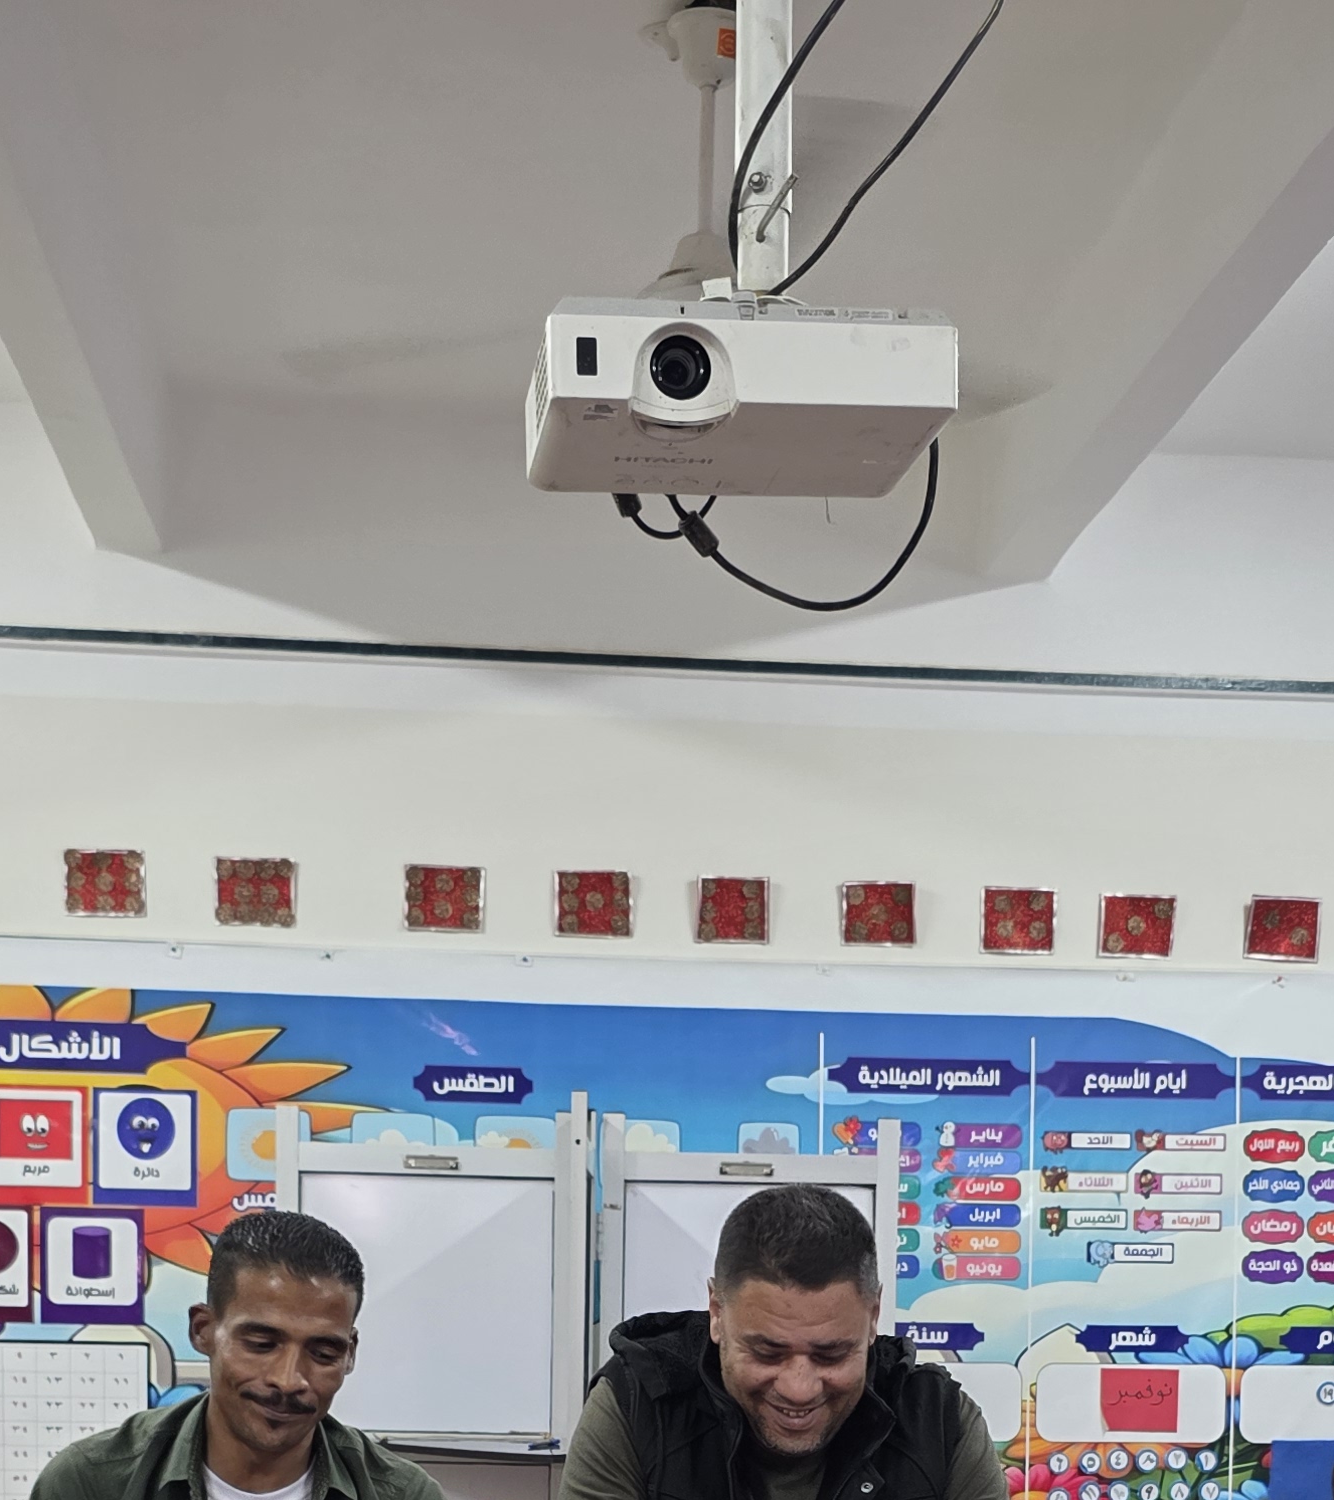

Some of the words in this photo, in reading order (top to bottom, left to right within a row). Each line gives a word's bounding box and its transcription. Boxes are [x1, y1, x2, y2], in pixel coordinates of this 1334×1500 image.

[432, 1073, 515, 1095] الطقس
[858, 1065, 931, 1088] الميلادية
[935, 1065, 1001, 1091] الشهور
[1083, 1070, 1151, 1096] الأسبوع
[970, 1129, 1003, 1144] يناير
[1175, 1137, 1216, 1147] السبت
[967, 1153, 1004, 1169] فبراير
[966, 1181, 1004, 1196] مارس
[1074, 1214, 1120, 1226] الخميس
[1250, 1219, 1297, 1235] رمضان
[969, 1236, 999, 1250] مايو
[966, 1262, 1003, 1277] يونيو
[1248, 1259, 1280, 1273] الحجة
[1283, 1259, 1298, 1274] ذو
[1109, 1329, 1156, 1349] شهر
[1106, 1382, 1174, 1407] نوفمبر
